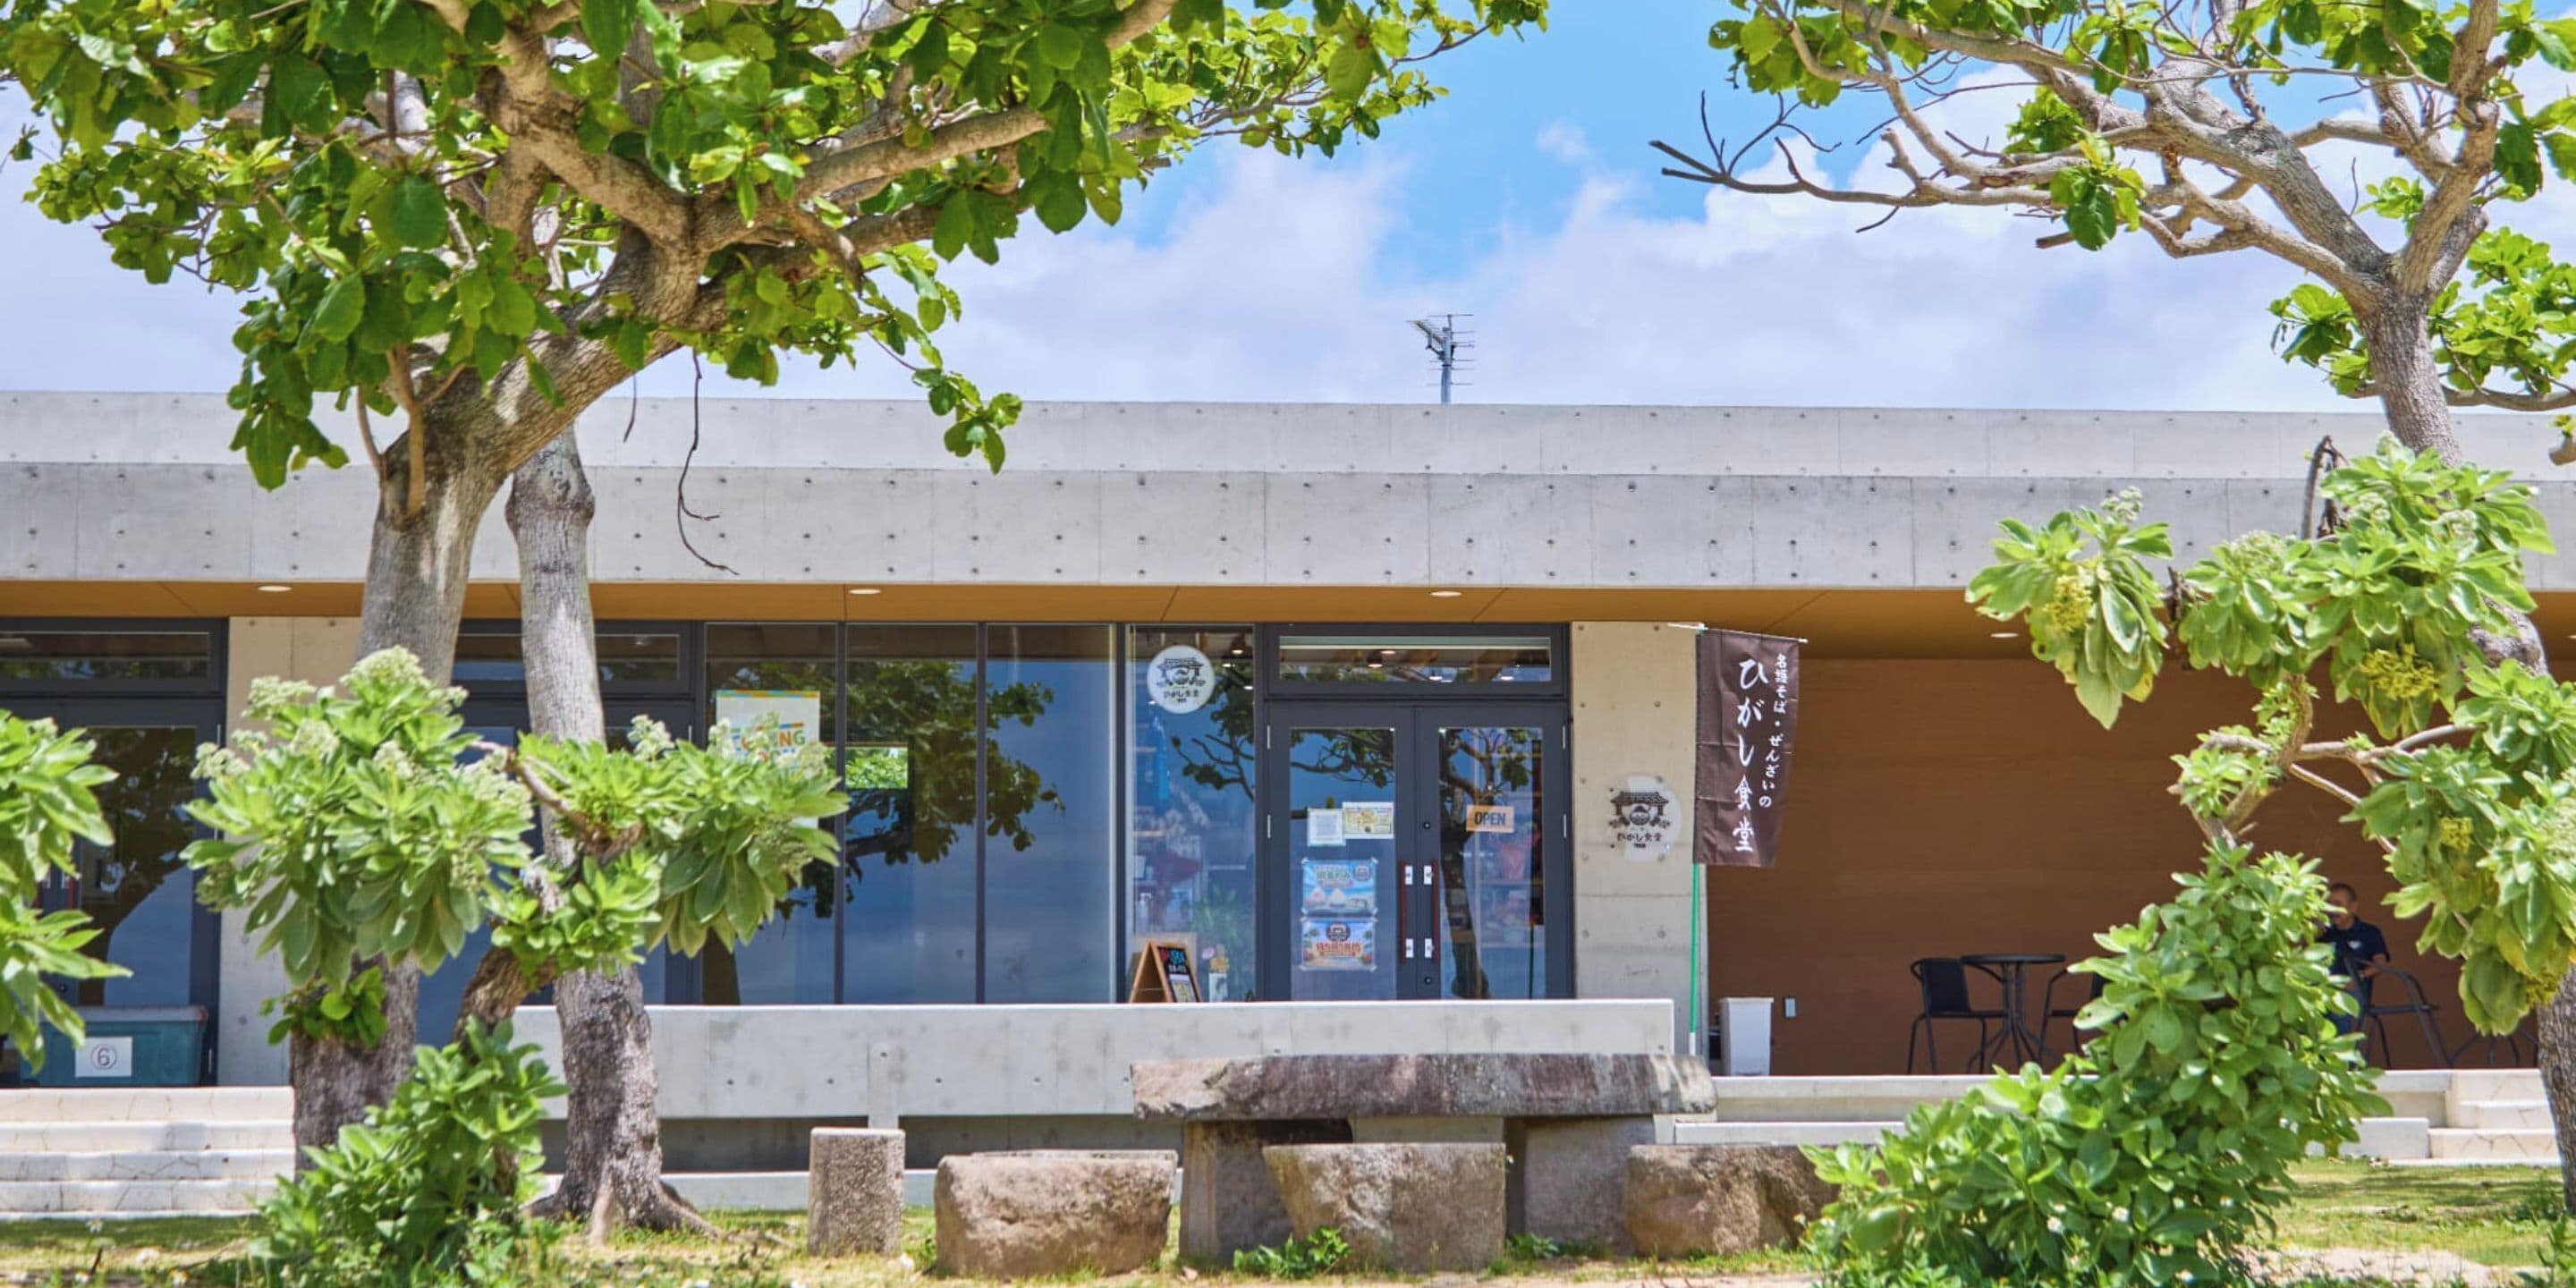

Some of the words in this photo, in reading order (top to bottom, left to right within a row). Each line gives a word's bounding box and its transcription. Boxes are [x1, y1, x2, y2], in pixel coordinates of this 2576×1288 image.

[1733, 659, 1768, 852] ひがし食堂
[1474, 810, 1506, 826] OPEN
